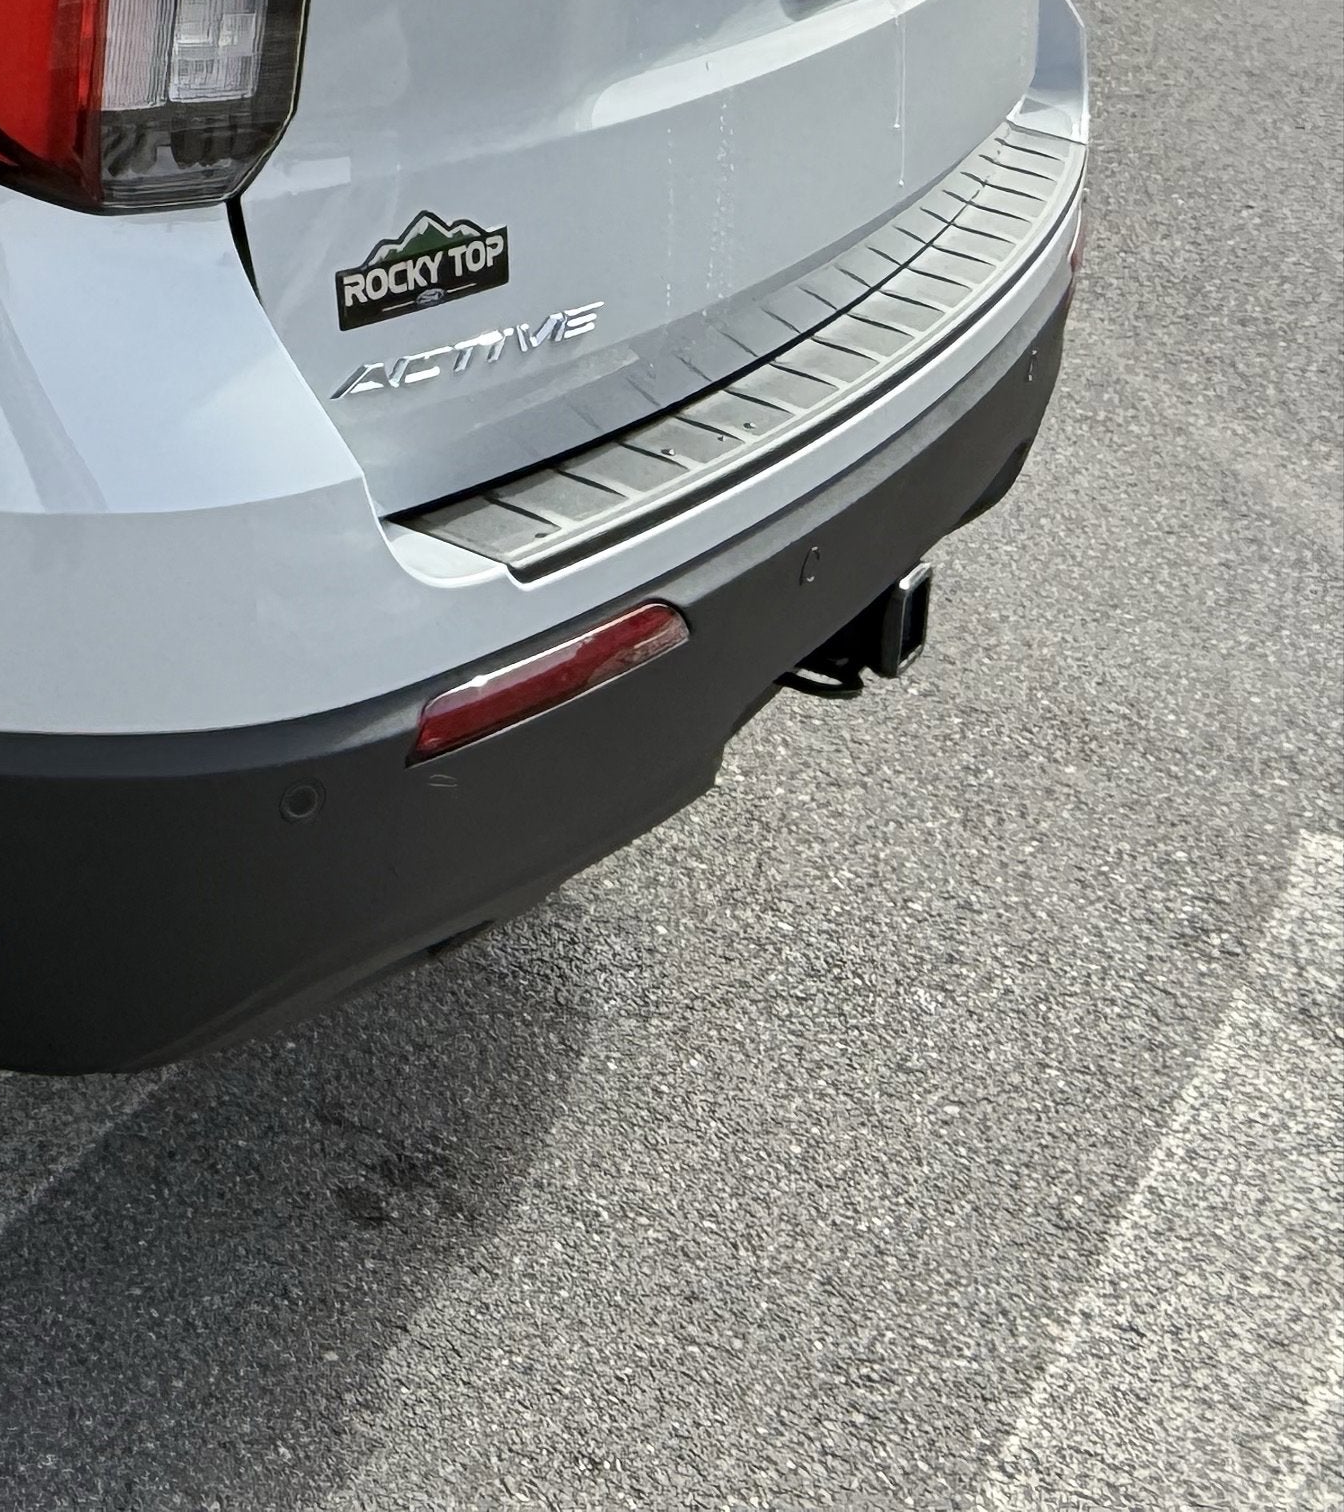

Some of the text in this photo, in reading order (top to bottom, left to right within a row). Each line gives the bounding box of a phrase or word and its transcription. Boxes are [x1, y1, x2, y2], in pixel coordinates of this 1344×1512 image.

[342, 235, 505, 306] ROCKY TOP
[330, 301, 605, 400] ACTIVE
